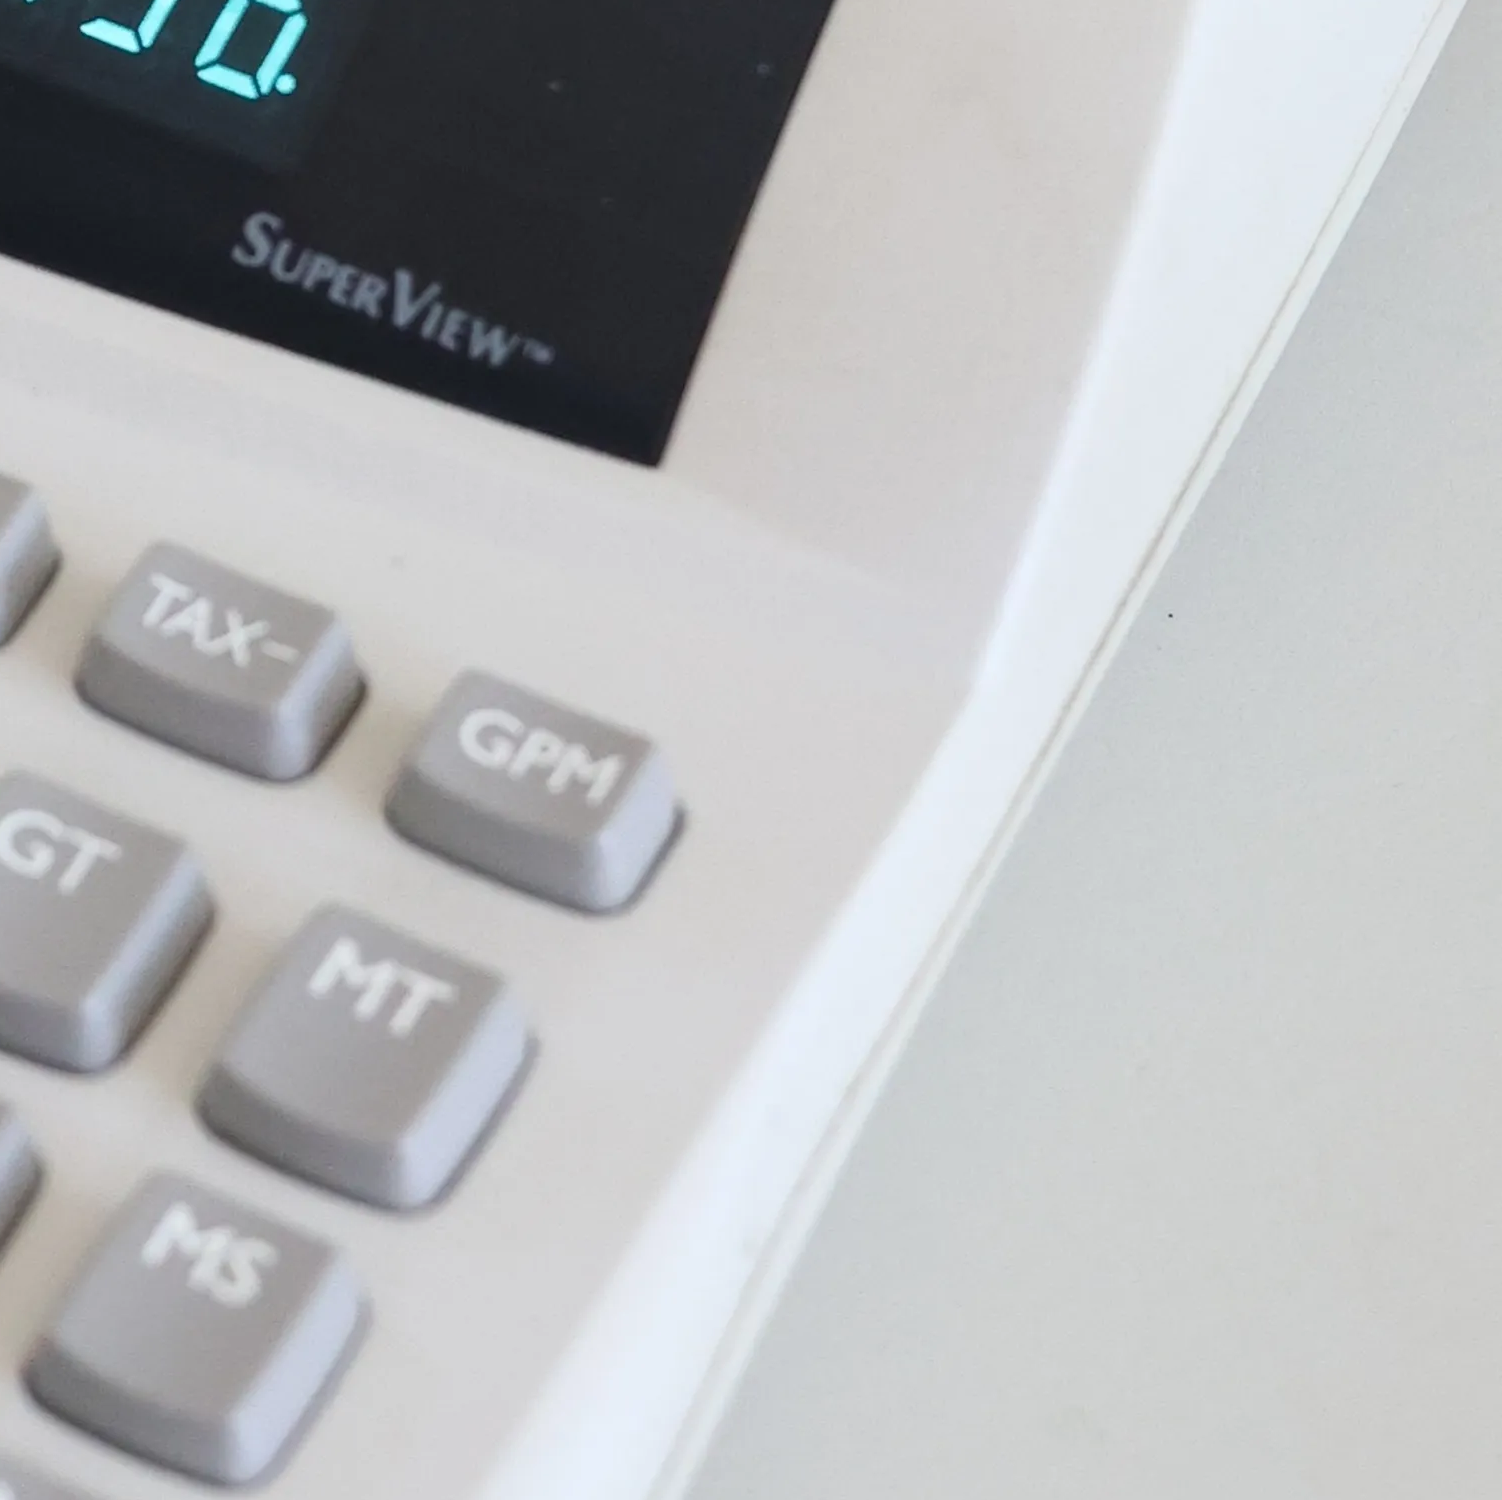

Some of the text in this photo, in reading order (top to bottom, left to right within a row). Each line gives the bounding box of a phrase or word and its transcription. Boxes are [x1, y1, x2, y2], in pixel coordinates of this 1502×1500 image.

[459, 706, 620, 801] GPM
[308, 937, 455, 1034] MT
[141, 1202, 281, 1308] MS
